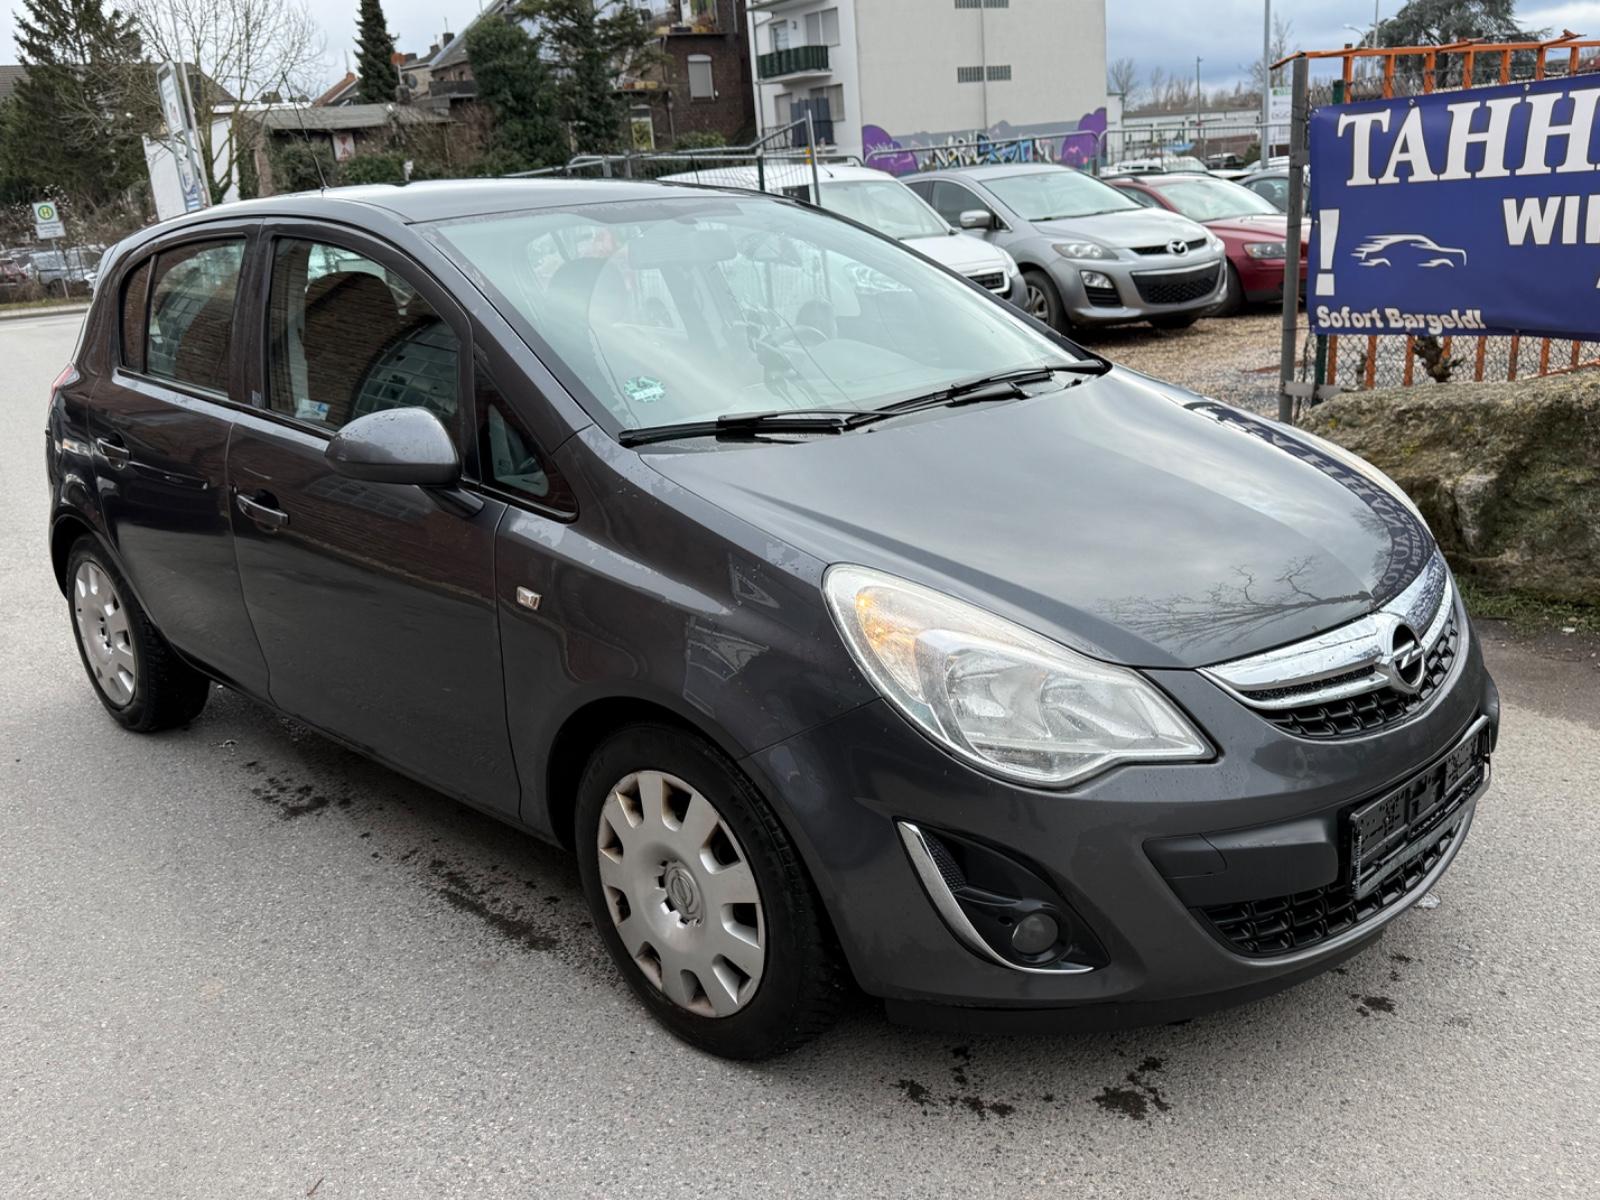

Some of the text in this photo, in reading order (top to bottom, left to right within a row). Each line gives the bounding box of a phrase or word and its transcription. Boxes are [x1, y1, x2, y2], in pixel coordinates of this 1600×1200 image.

[1338, 88, 1600, 186] TAHH
[1316, 305, 1486, 335] Sofort Bargeld!
